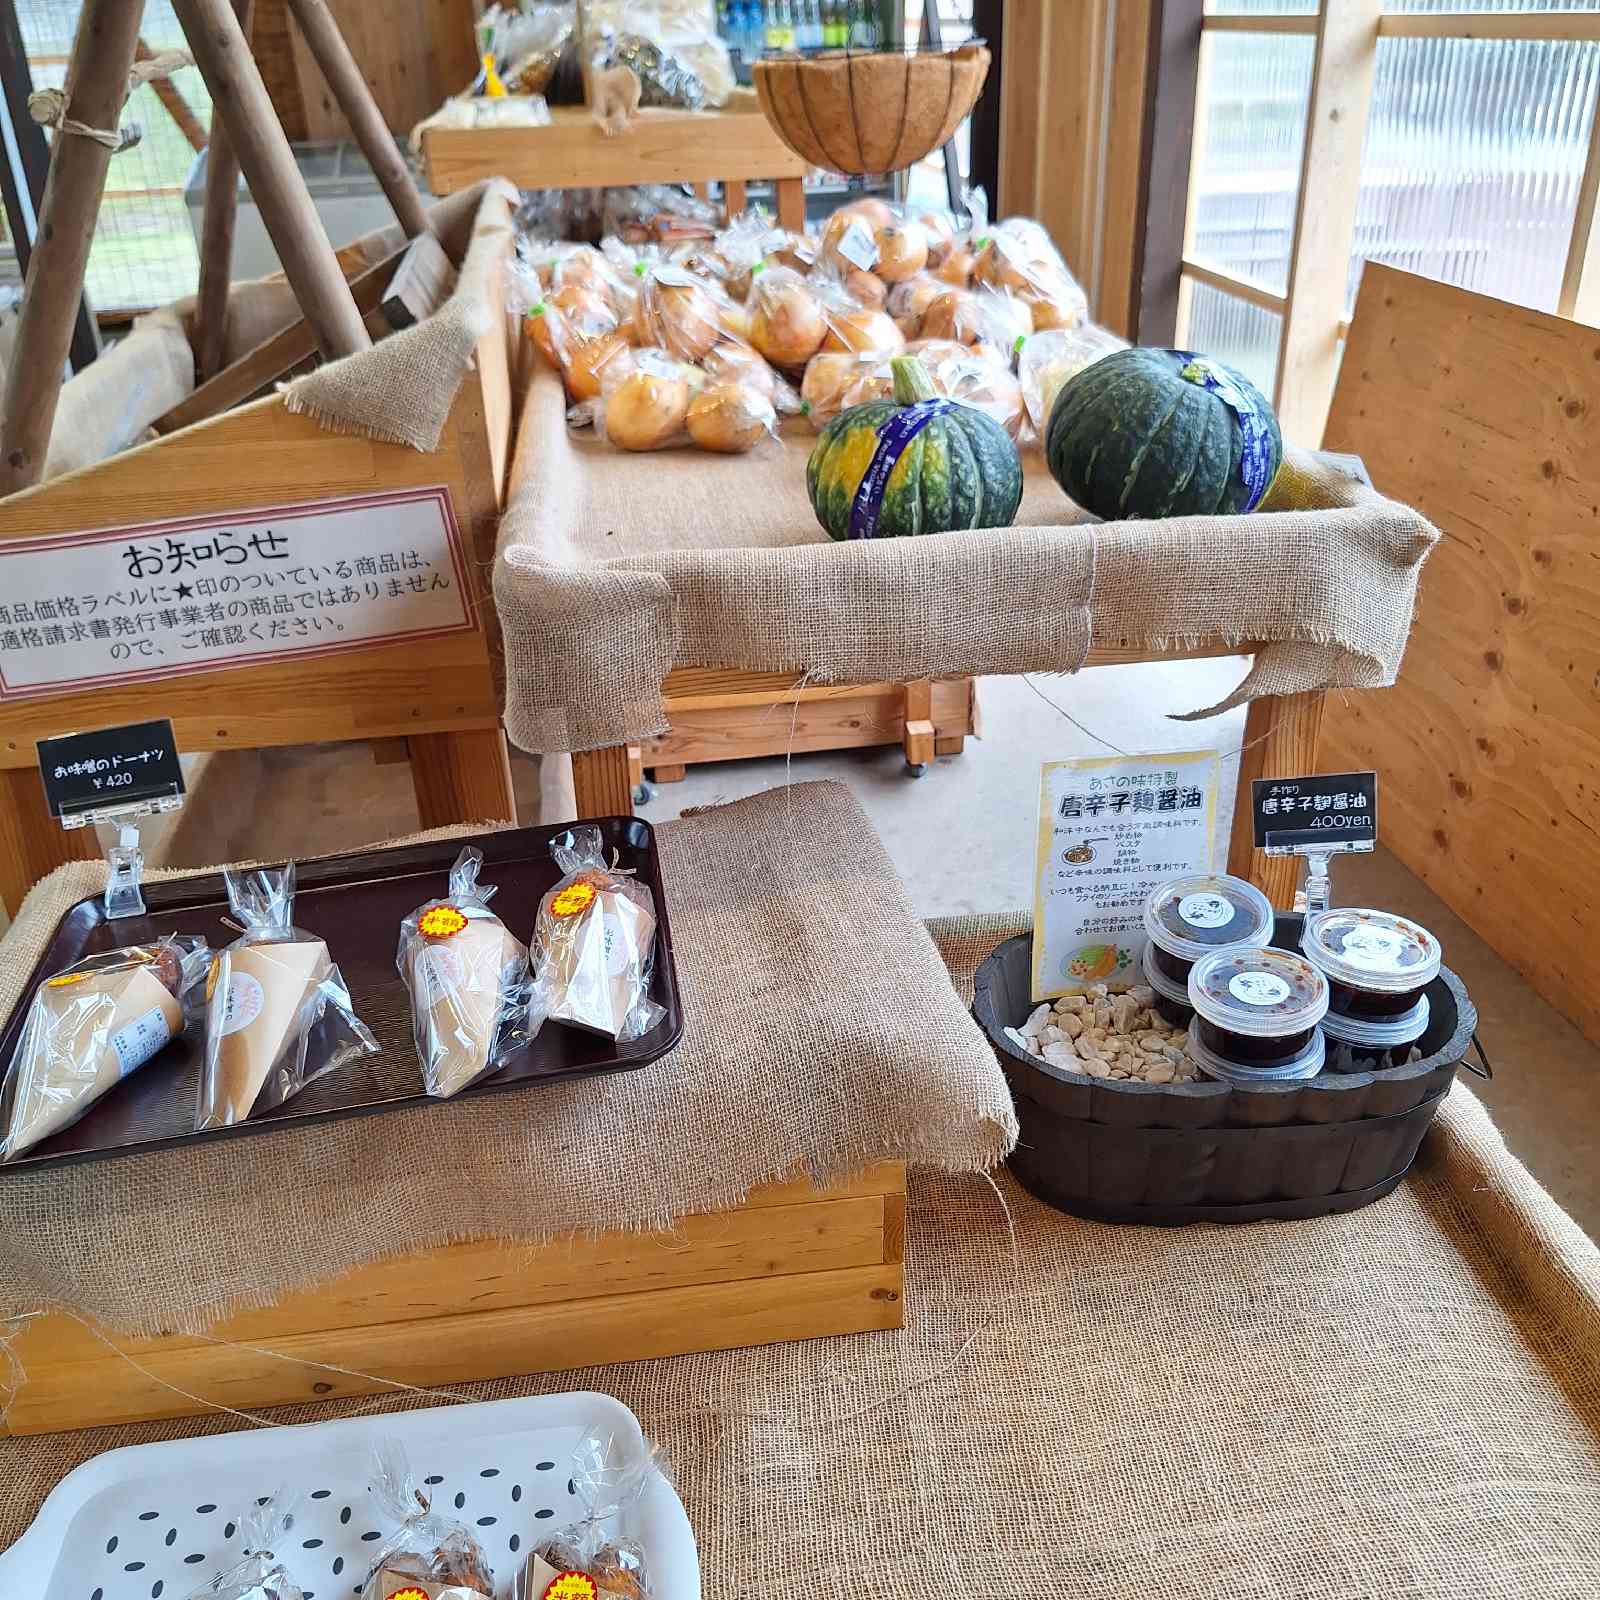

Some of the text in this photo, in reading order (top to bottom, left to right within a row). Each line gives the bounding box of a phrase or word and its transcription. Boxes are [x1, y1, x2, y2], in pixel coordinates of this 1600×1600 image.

[122, 530, 289, 579] お知らせ
[0, 573, 450, 650] 適格請求書発行事業者の商品ではありません
[110, 615, 345, 661] ので、ご確認ください。
[54, 749, 164, 779] お味噌のドーナツ
[1270, 785, 1300, 797] 手作り
[1310, 814, 1371, 829] 400yen
